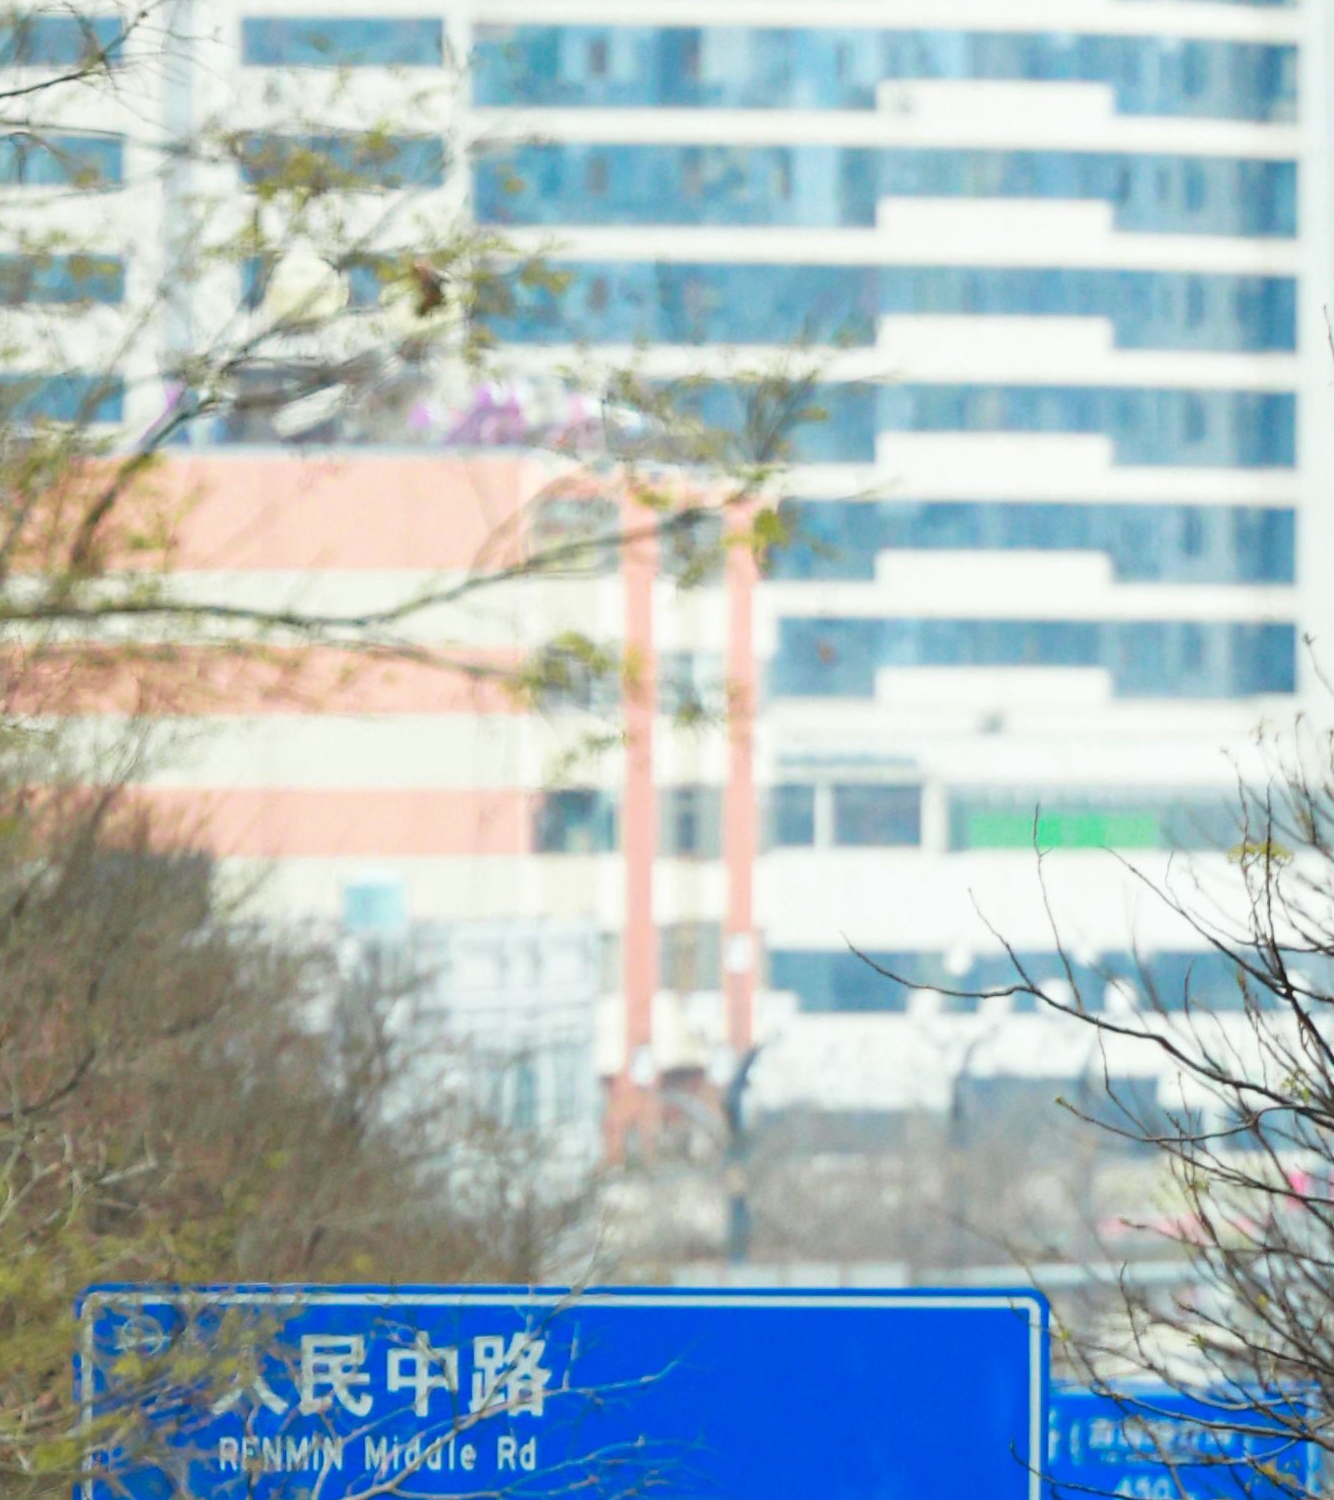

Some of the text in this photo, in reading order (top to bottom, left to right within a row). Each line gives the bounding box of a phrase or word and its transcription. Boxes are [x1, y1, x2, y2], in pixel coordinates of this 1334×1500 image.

[218, 1436, 537, 1472] RENMIN Middle Rd
